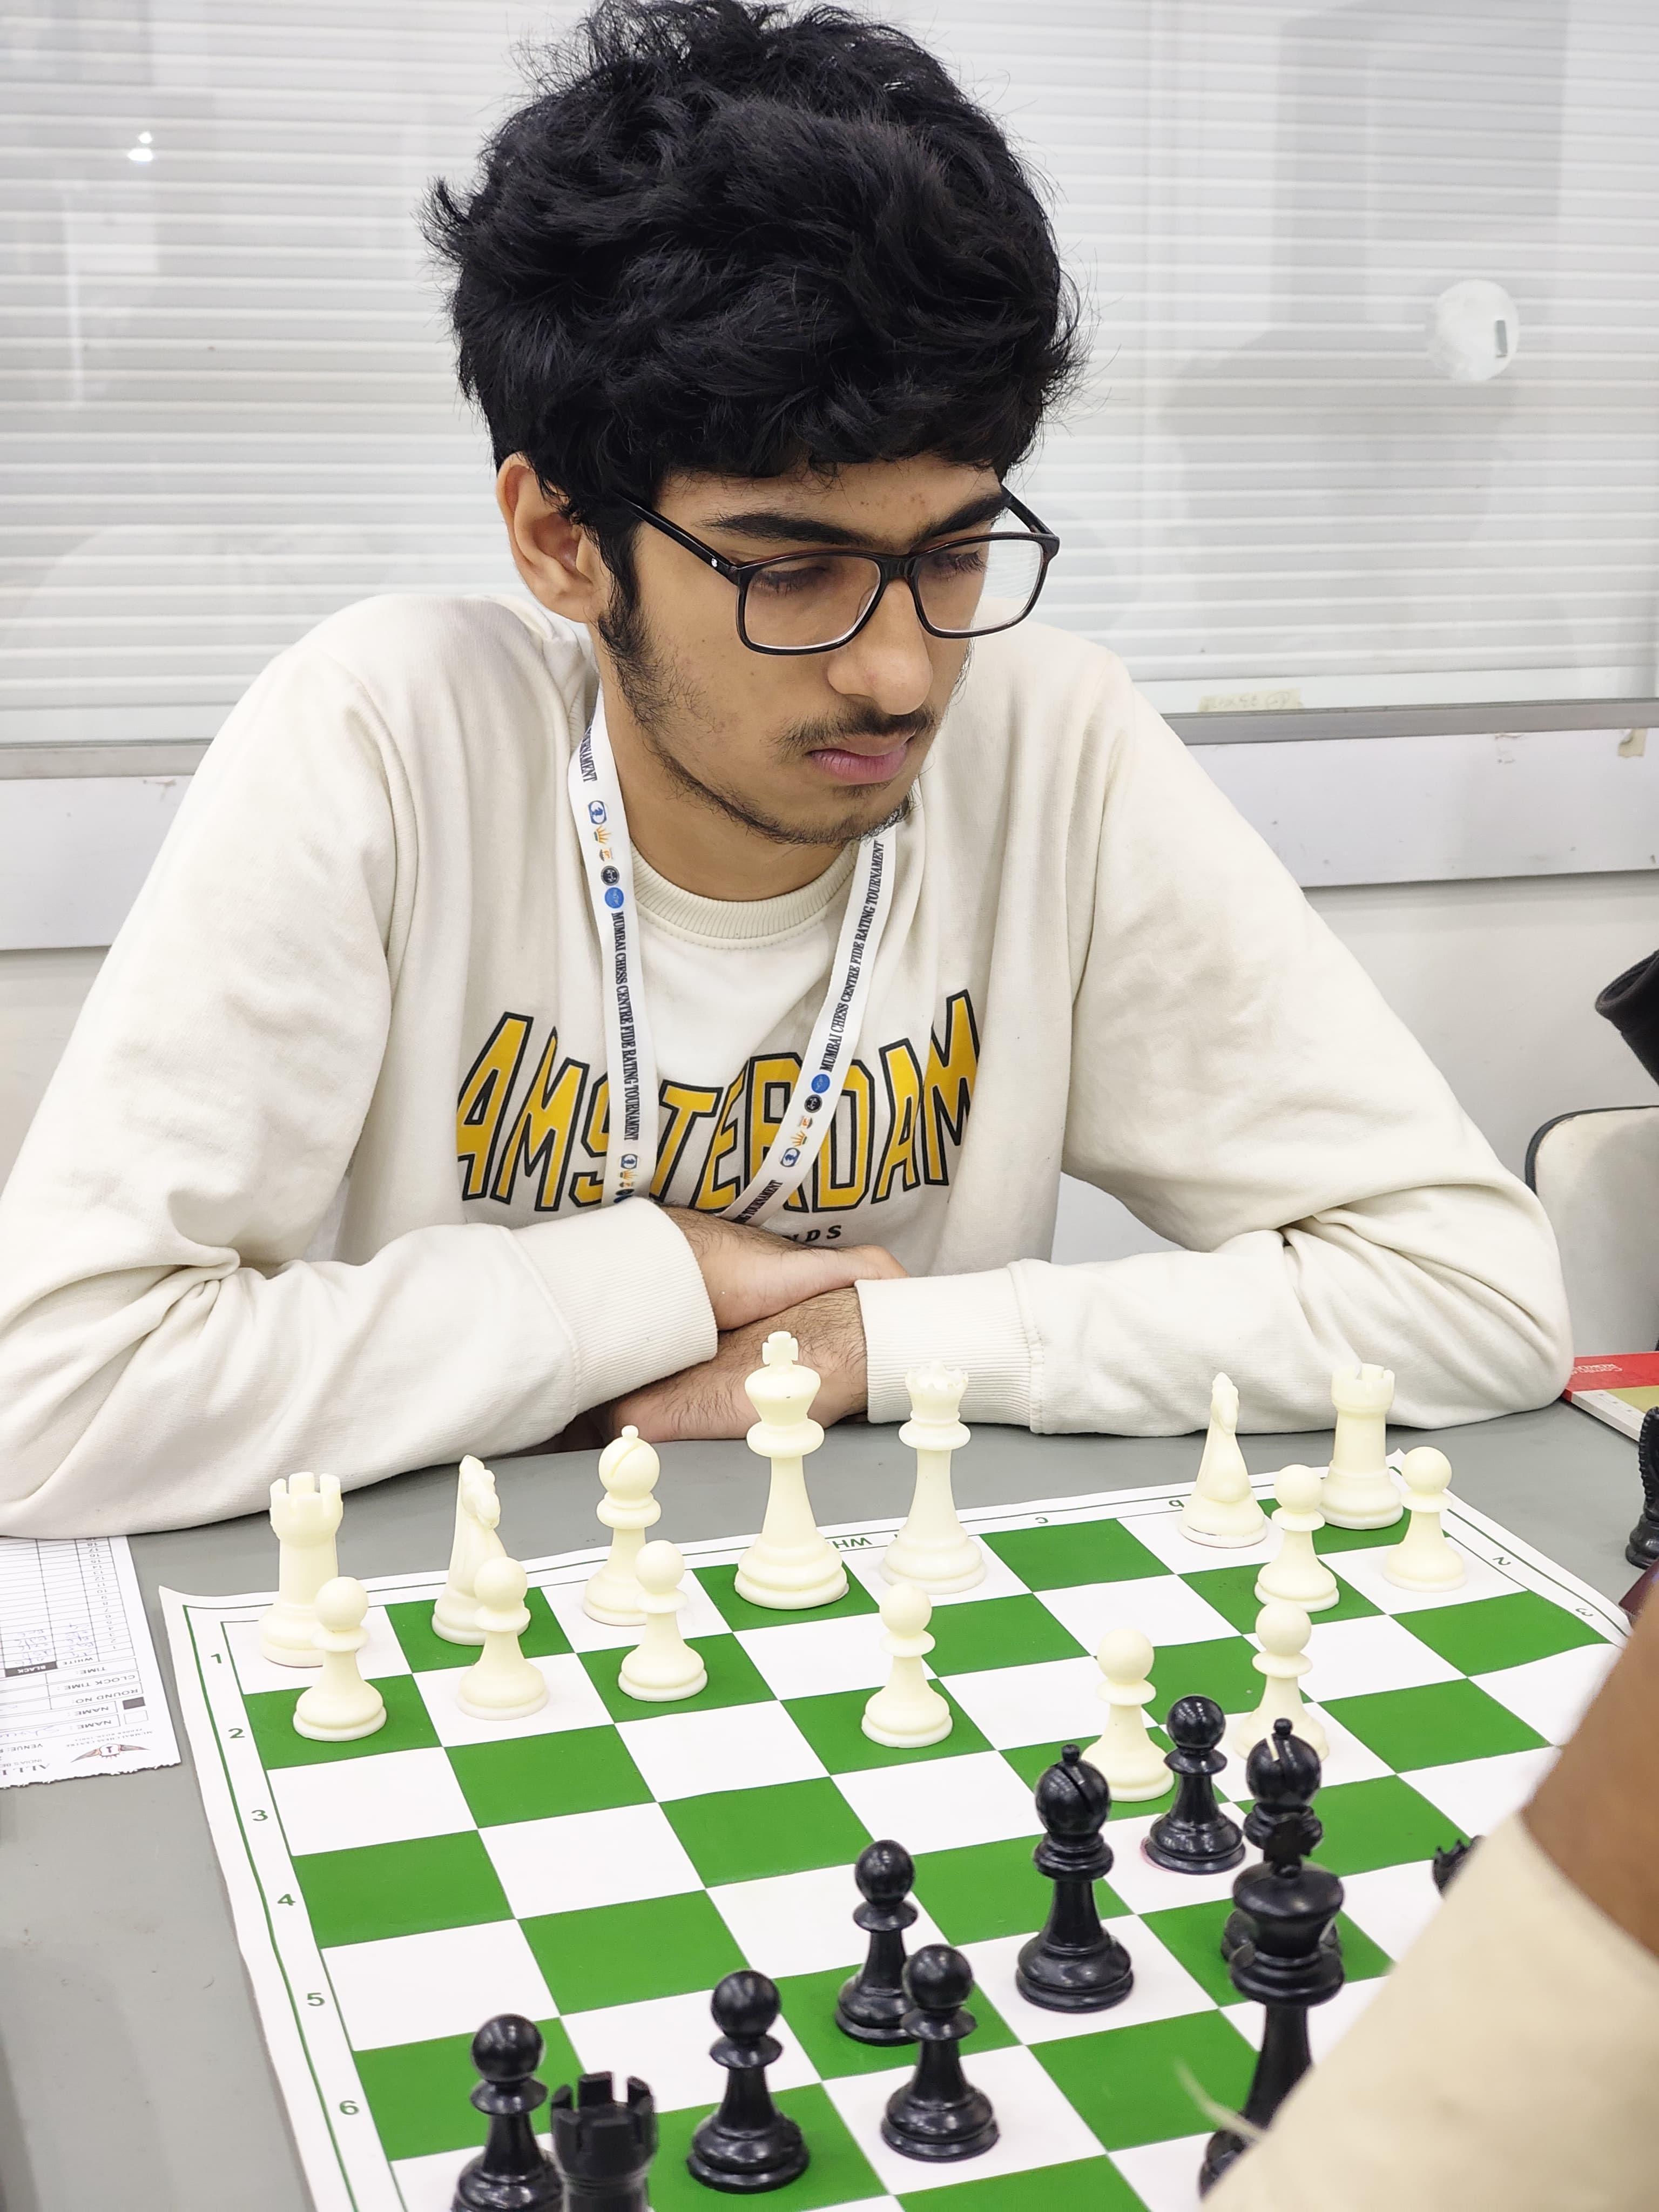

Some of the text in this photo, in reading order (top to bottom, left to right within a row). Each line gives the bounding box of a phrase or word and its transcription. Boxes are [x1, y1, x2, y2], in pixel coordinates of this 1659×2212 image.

[819, 840, 885, 1073] MUMBAI CHESS CENTRE FIDE RATING TOURNAMENT
[611, 911, 640, 1141] MUMBAI CHESS CENTRE FIDE RATING TOURNAMENT
[747, 1179, 784, 1217] TOURNAMENT
[1493, 1556, 1512, 1566] 2
[1575, 1608, 1594, 1617] 3
[211, 1653, 222, 1664] 1
[17, 1665, 46, 1674] BLACK
[95, 1675, 136, 1685] CLOCK
[97, 1689, 138, 1700] ROUND
[228, 1728, 245, 1738] 2
[7, 1743, 43, 1751] VENUE:
[13, 1763, 51, 1773] ALL
[251, 1810, 268, 1821] 3
[277, 1894, 296, 1906] 4
[307, 1992, 325, 2006] 5
[339, 2100, 360, 2115] 6
